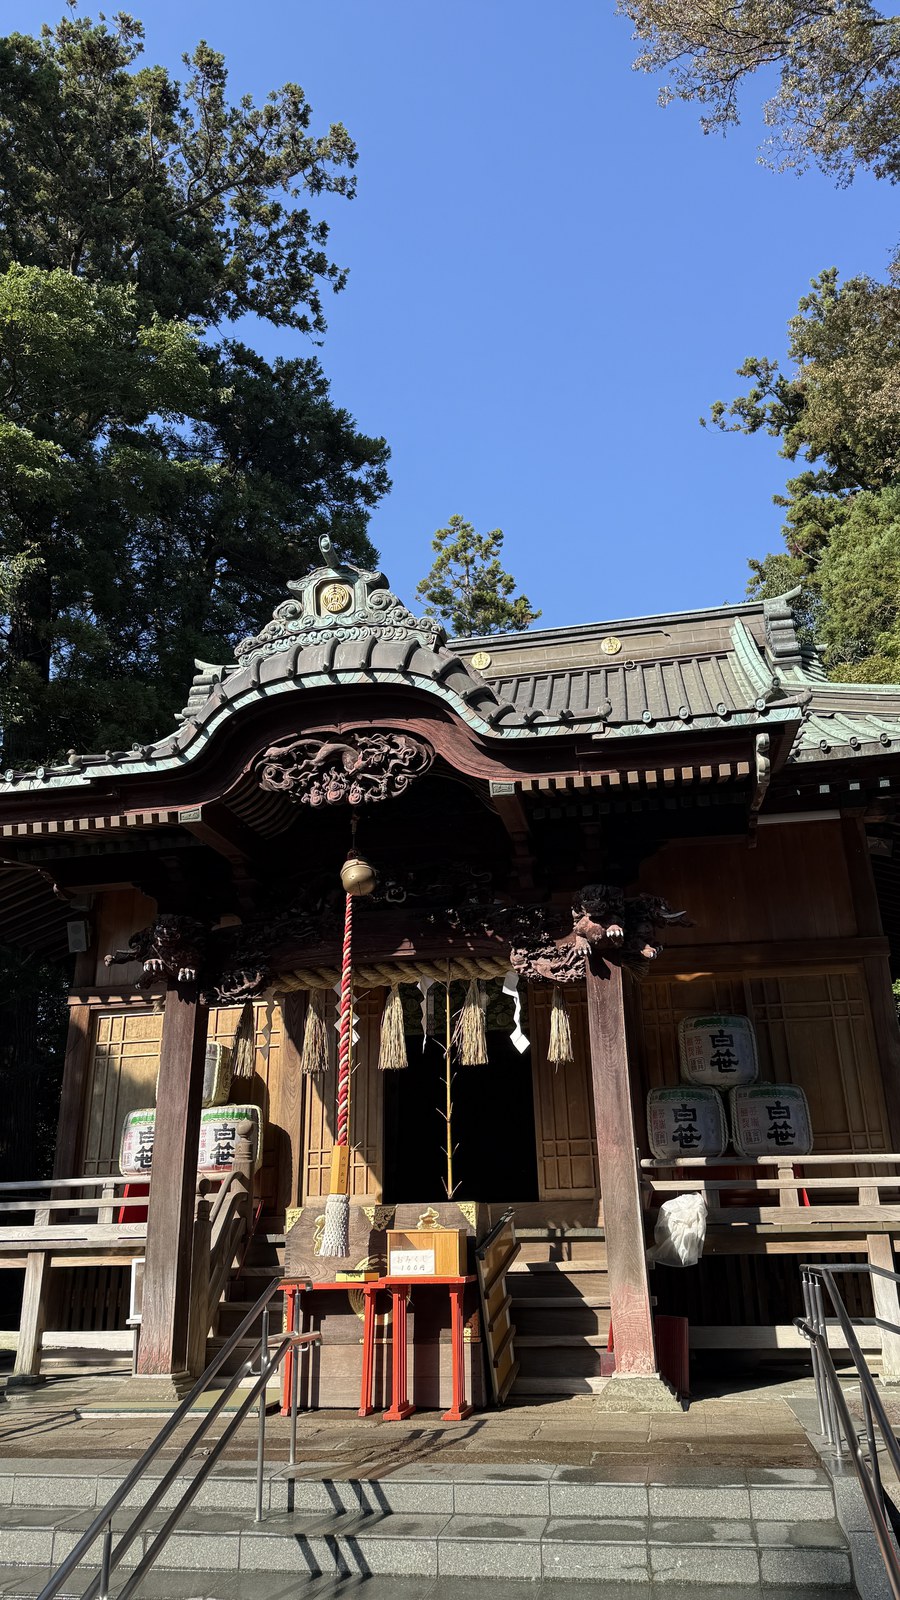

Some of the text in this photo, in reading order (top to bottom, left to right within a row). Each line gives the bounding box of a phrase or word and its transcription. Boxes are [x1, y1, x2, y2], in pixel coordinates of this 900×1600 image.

[709, 1029, 739, 1073] 白笹
[209, 1122, 236, 1165] 白笹
[671, 1103, 702, 1148] 白笹
[765, 1100, 796, 1146] 白笹
